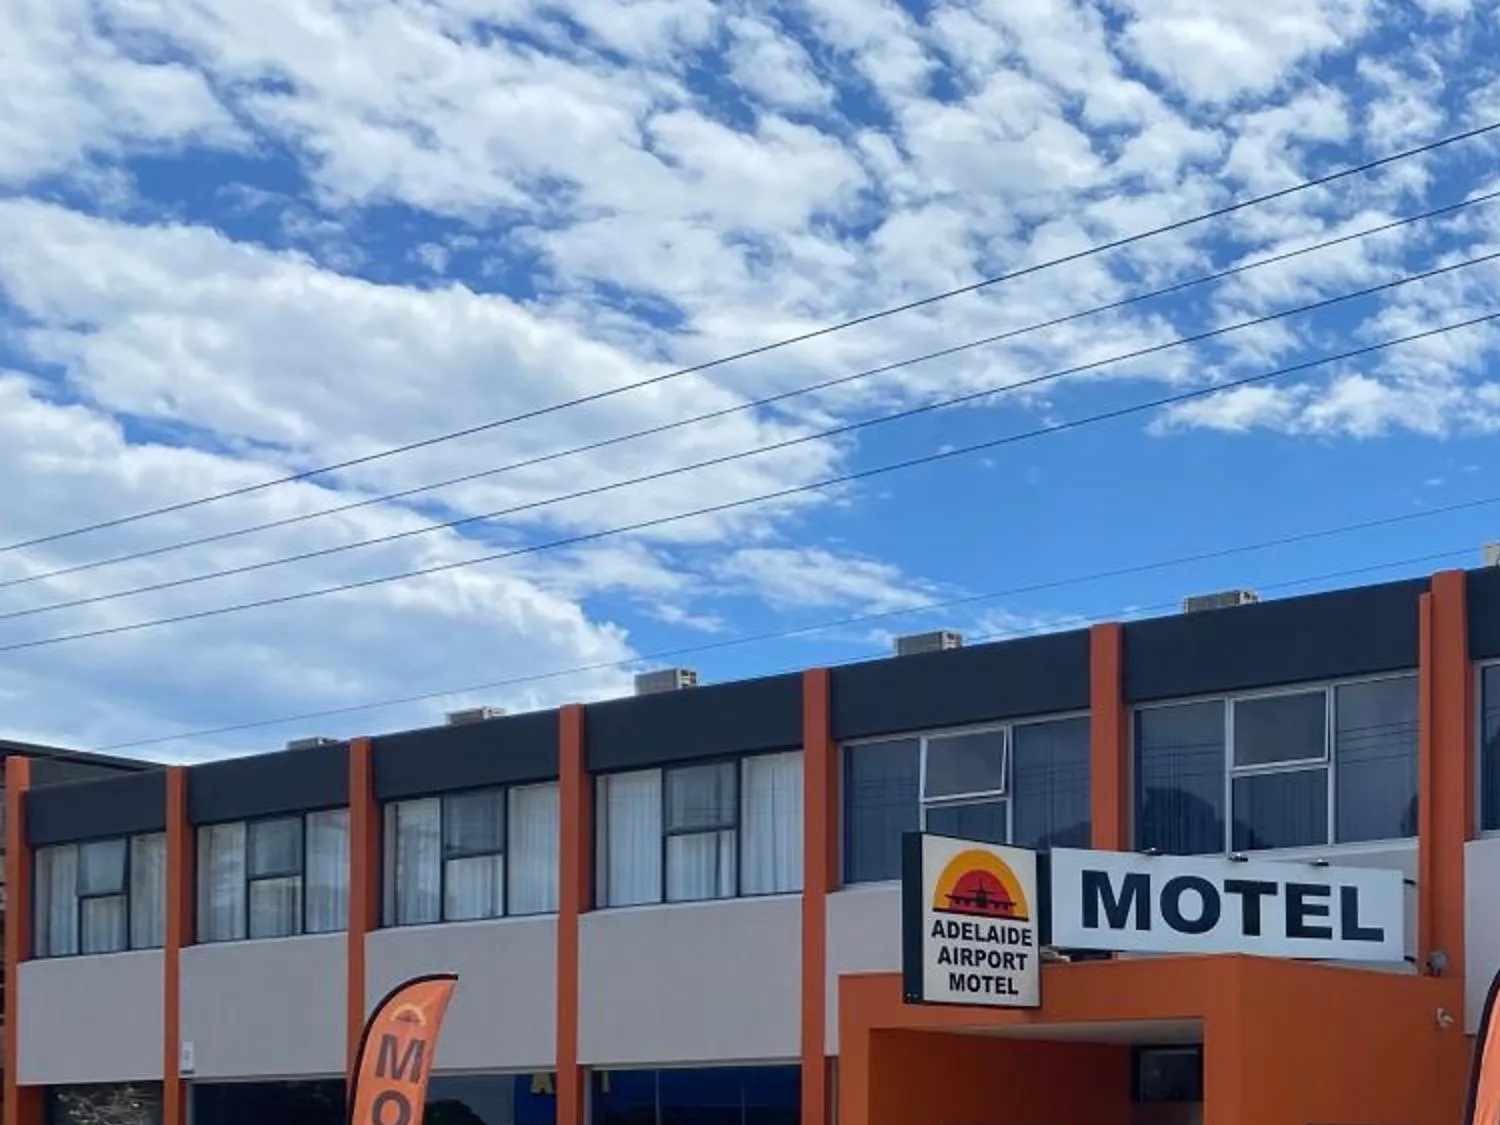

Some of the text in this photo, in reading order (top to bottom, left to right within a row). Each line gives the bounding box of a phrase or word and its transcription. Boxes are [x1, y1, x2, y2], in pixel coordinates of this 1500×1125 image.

[1081, 869, 1385, 943] MOTEL
[931, 919, 1033, 947] ADELAIDE
[938, 945, 1029, 971] AIRPORT
[949, 972, 1019, 996] MOTEL
